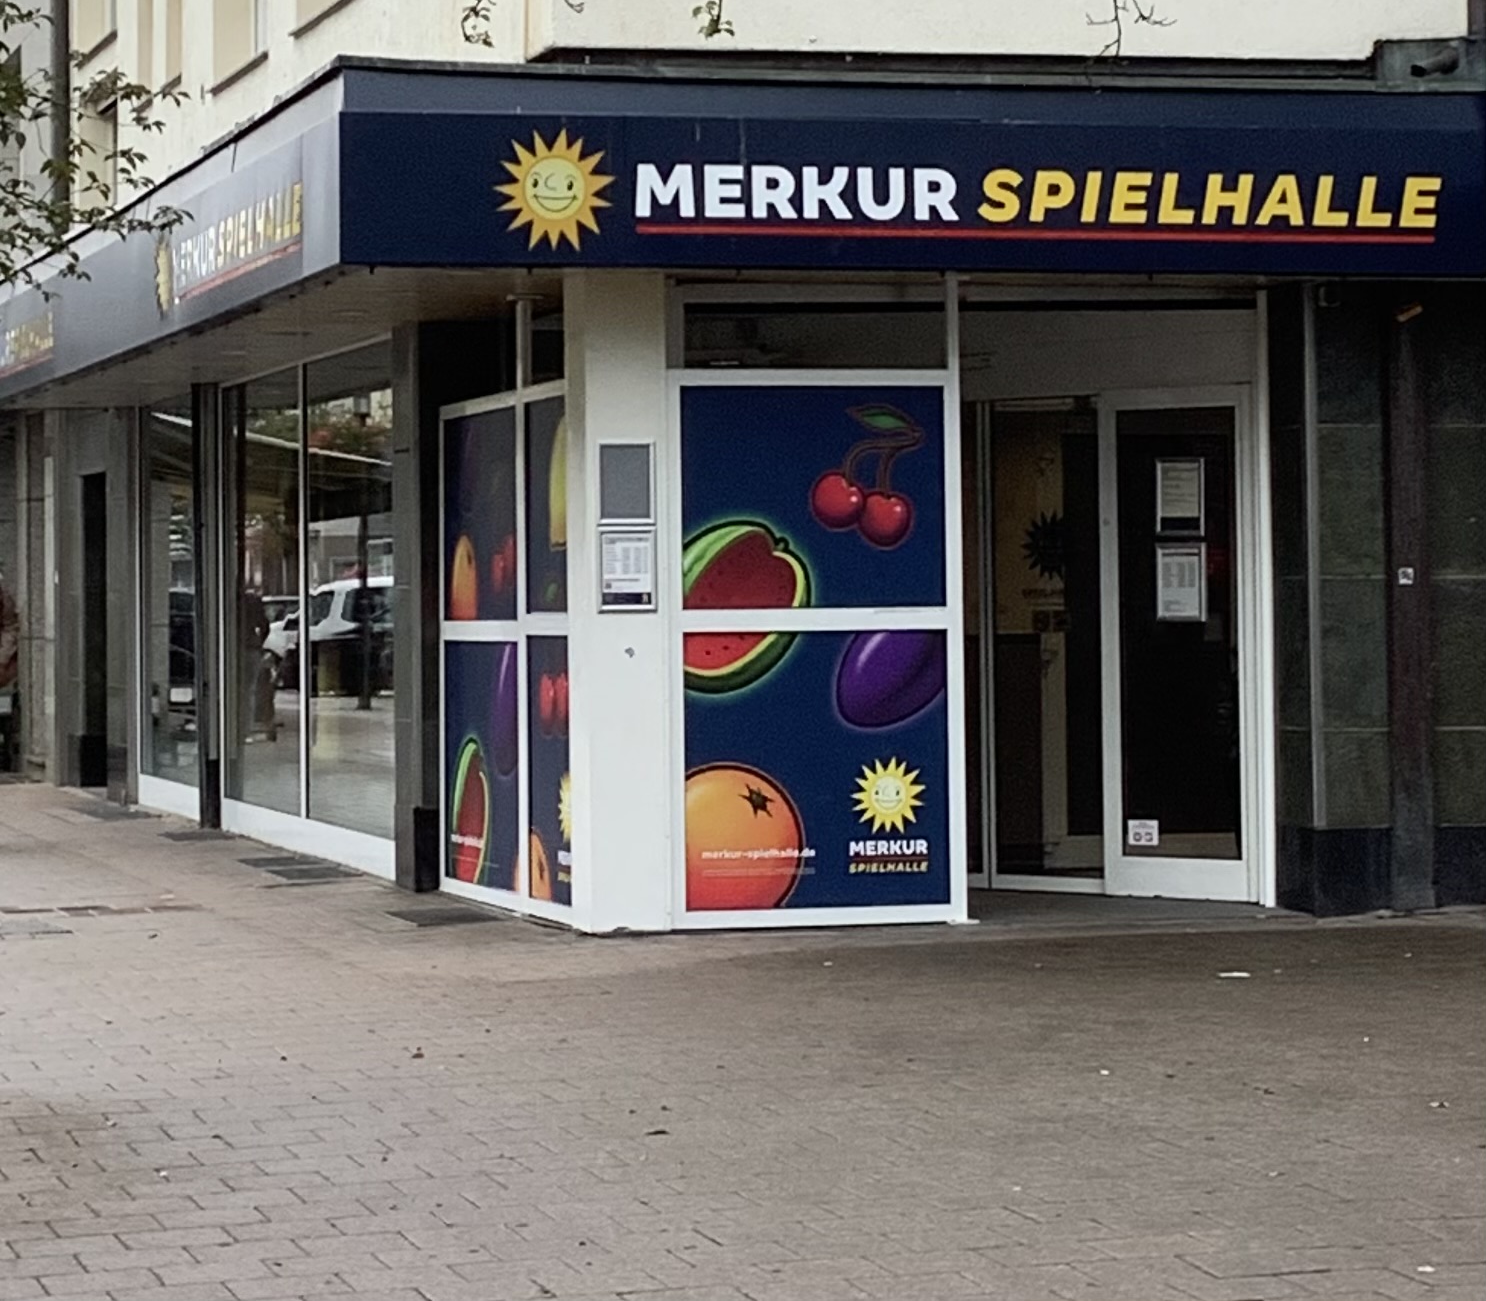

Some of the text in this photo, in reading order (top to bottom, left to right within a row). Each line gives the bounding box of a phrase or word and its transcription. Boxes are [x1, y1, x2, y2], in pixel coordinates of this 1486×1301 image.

[635, 163, 1442, 229] MERKUR SPIELHALLE
[701, 848, 816, 860] merkur-spielhalle.de
[849, 839, 929, 856] MERKUR
[848, 861, 929, 874] SPIELHALLE
